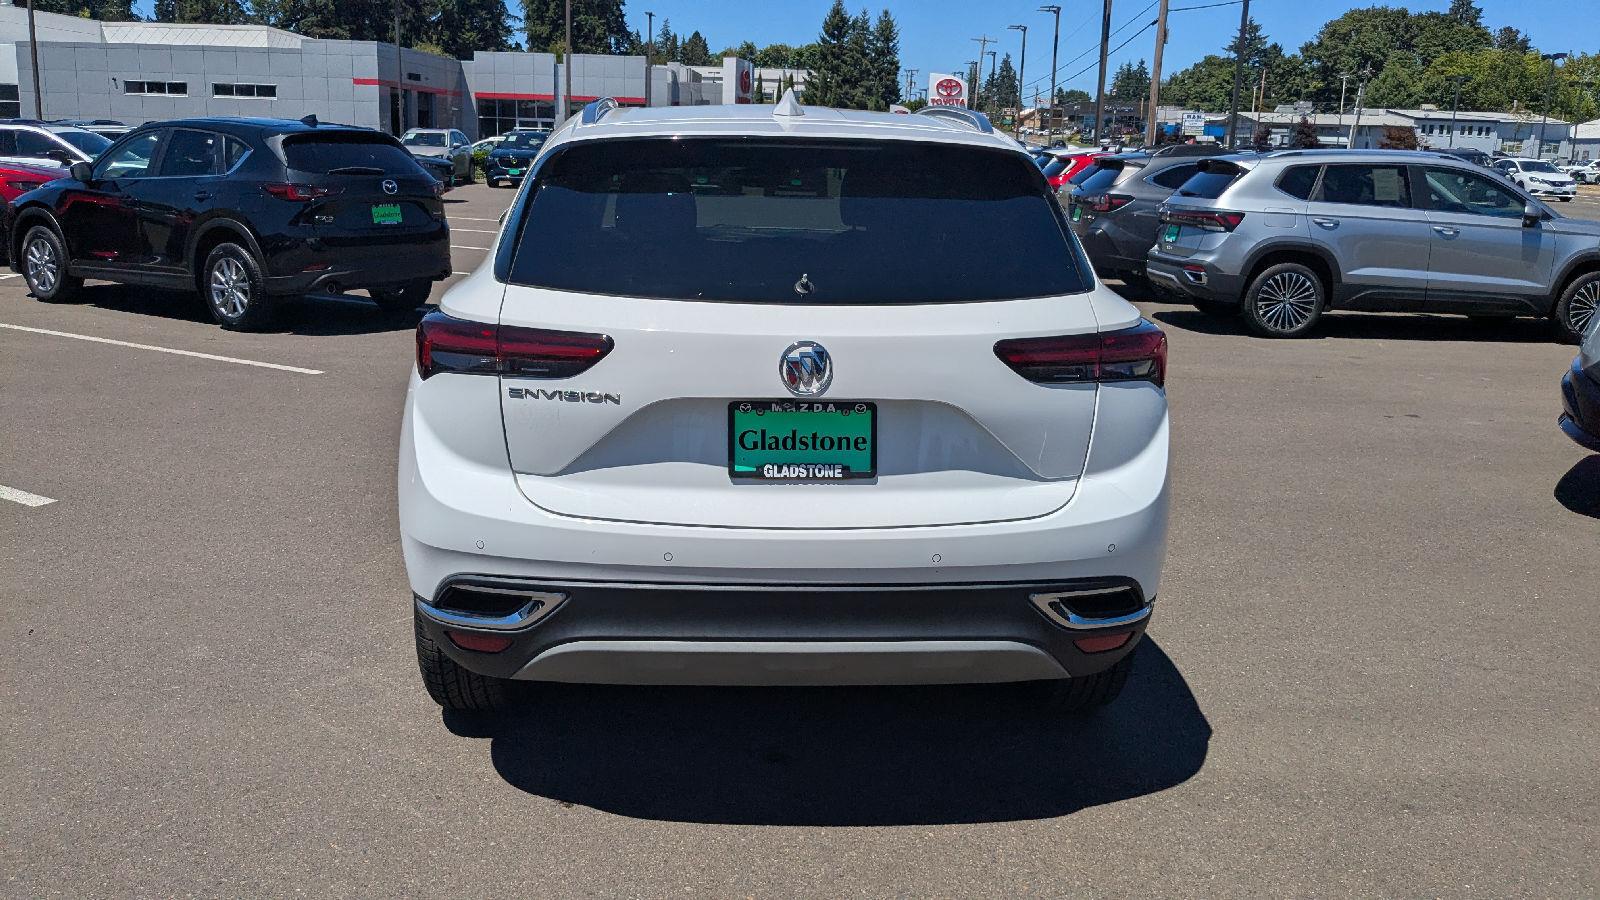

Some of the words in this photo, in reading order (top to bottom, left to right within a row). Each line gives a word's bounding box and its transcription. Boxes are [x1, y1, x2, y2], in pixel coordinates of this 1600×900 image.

[931, 98, 966, 106] TOYOTA
[508, 387, 621, 405] ENVISION
[738, 429, 867, 451] Gladstone
[763, 464, 843, 478] GLADSTONE
